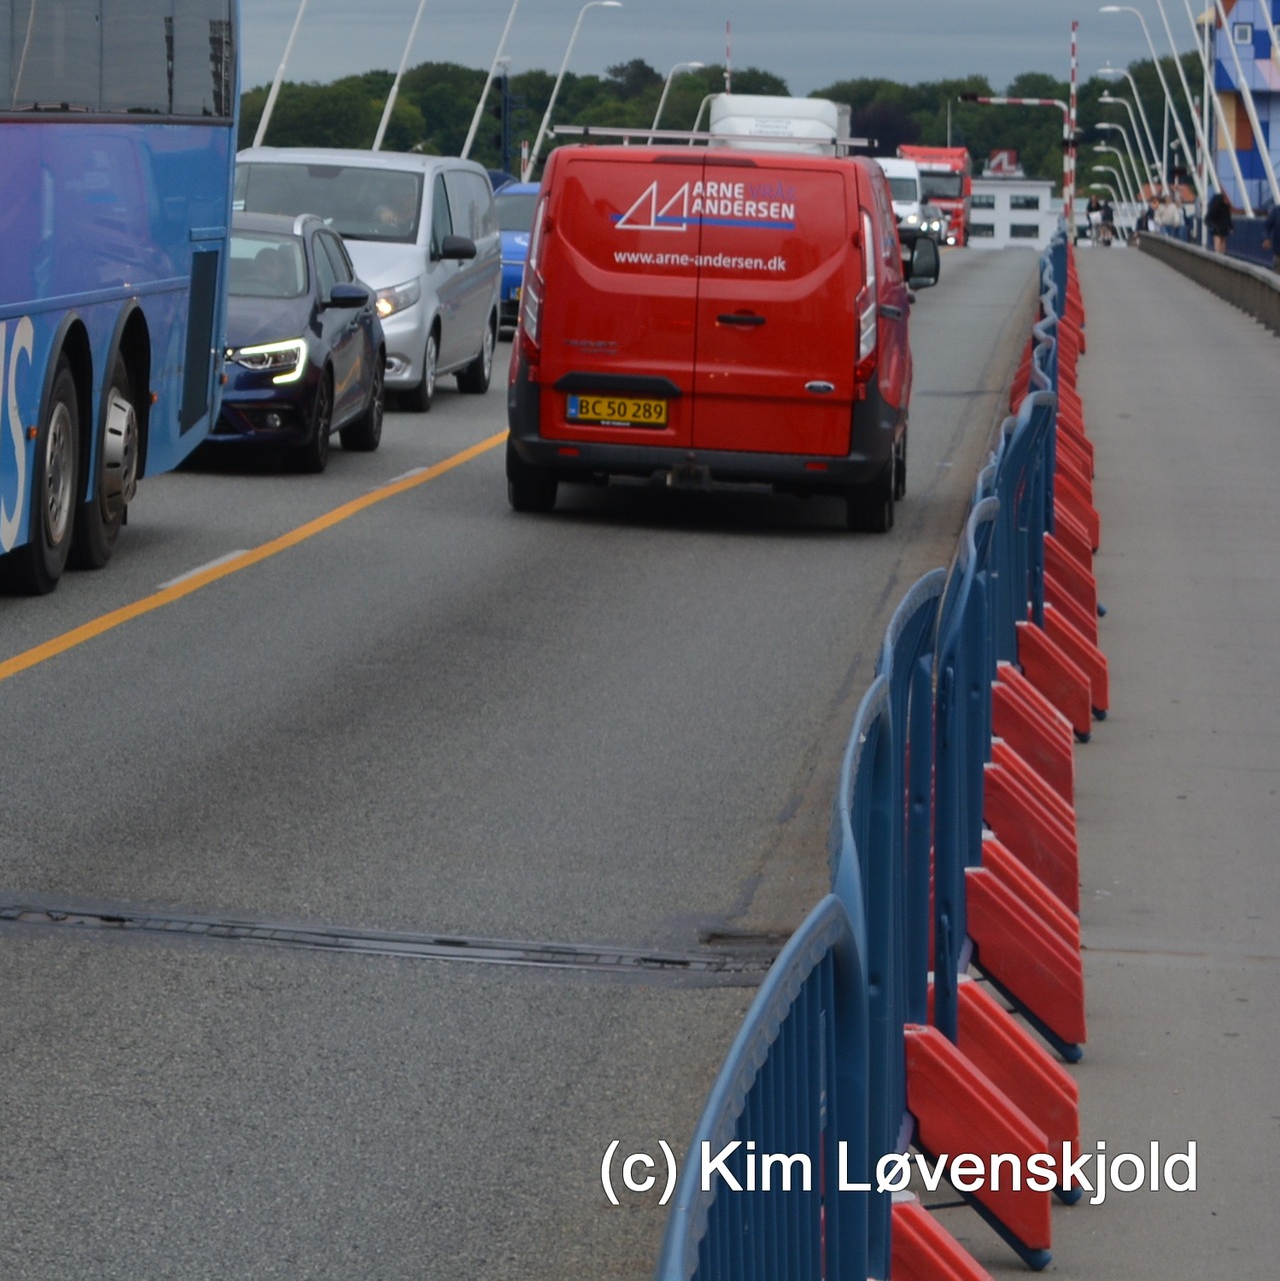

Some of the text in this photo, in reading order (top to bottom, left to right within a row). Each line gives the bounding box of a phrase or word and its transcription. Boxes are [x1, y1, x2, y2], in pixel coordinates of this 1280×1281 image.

[692, 181, 744, 199] ARNE
[691, 199, 795, 220] ANDERSEN
[614, 251, 786, 271] www.arne-andersen.dk
[580, 399, 664, 420] BC 50 289
